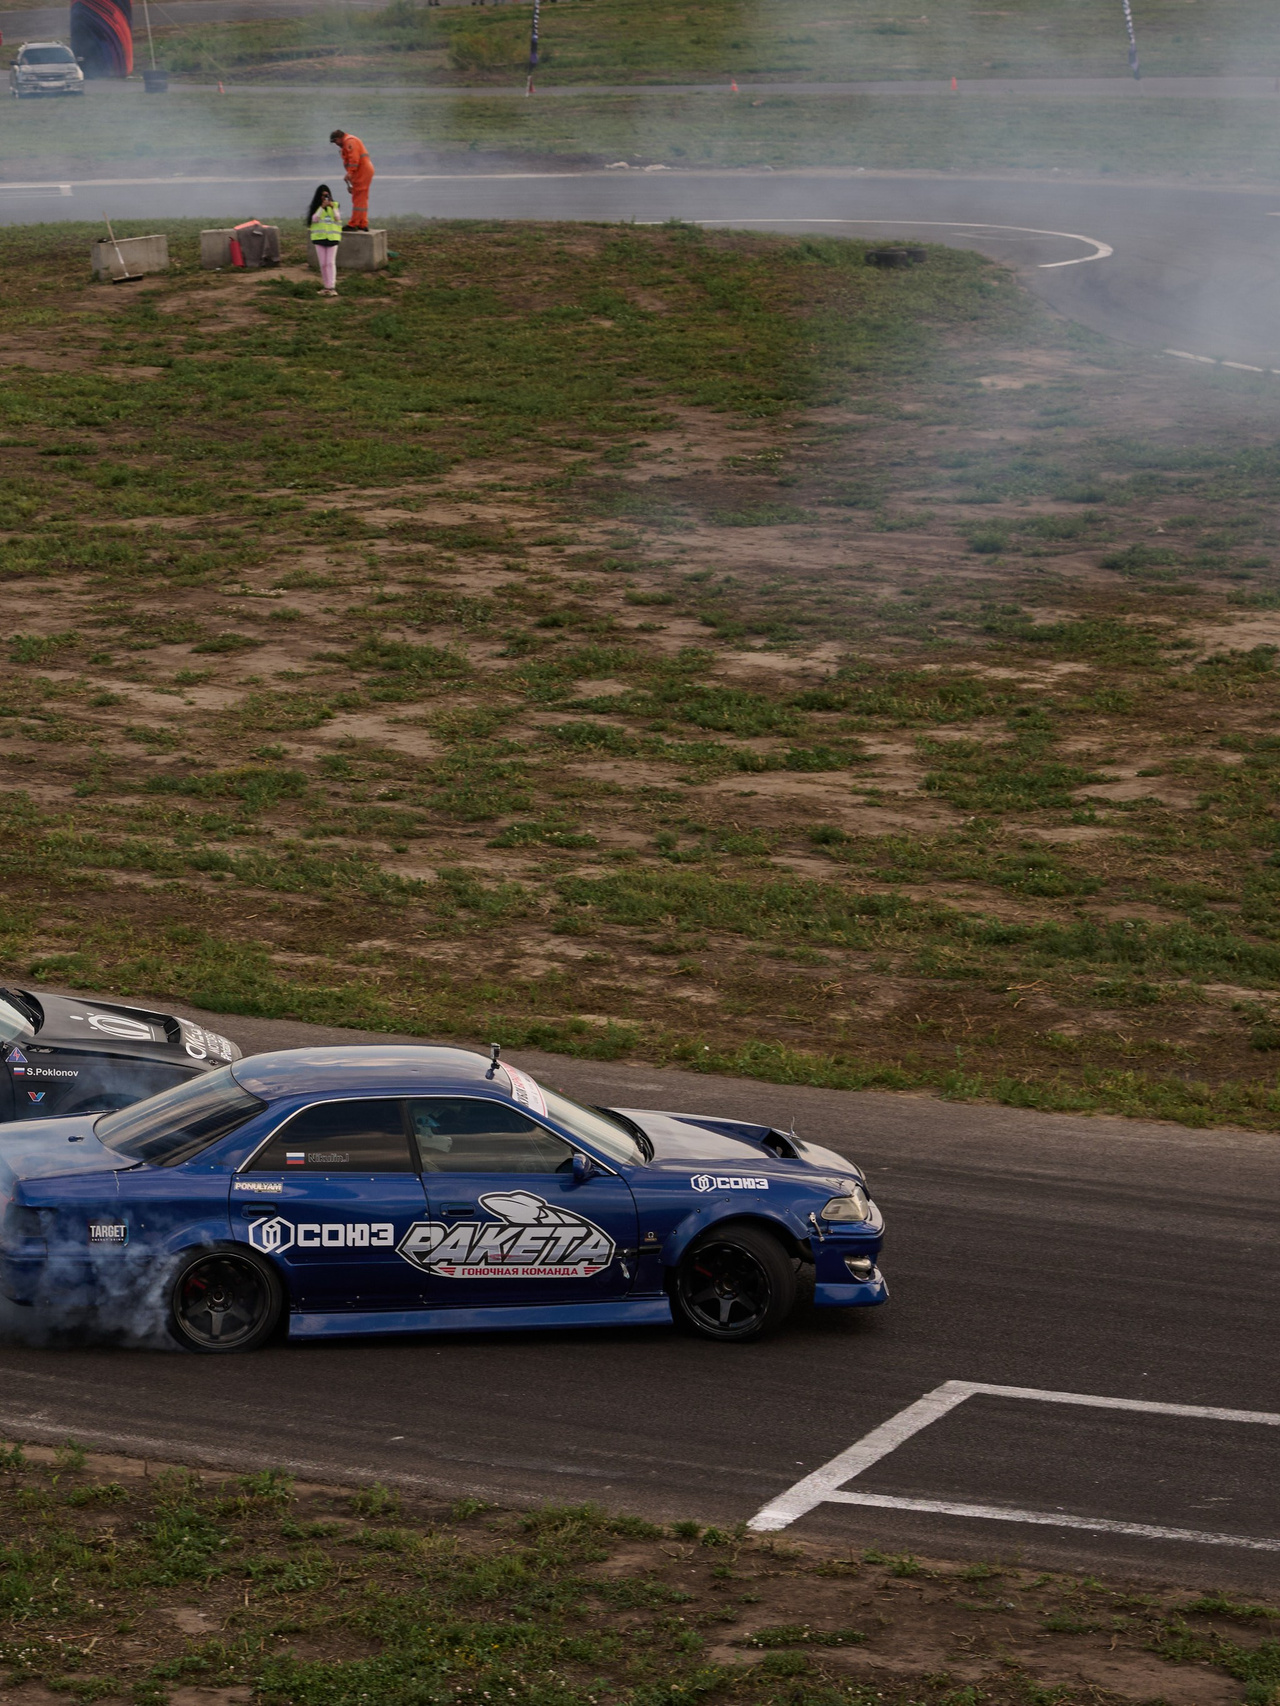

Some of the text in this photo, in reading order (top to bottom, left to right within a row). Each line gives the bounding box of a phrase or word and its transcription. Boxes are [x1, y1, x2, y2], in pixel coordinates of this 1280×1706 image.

[26, 1067, 79, 1077] S.Poklonov
[717, 1177, 769, 1190] СОЮЗ
[89, 1225, 127, 1238] TARGET
[297, 1223, 394, 1247] СОЮЗ
[403, 1226, 610, 1263] РАКЕТА
[462, 1267, 579, 1277] ГОНОЧНАЯ КОМАНДА
